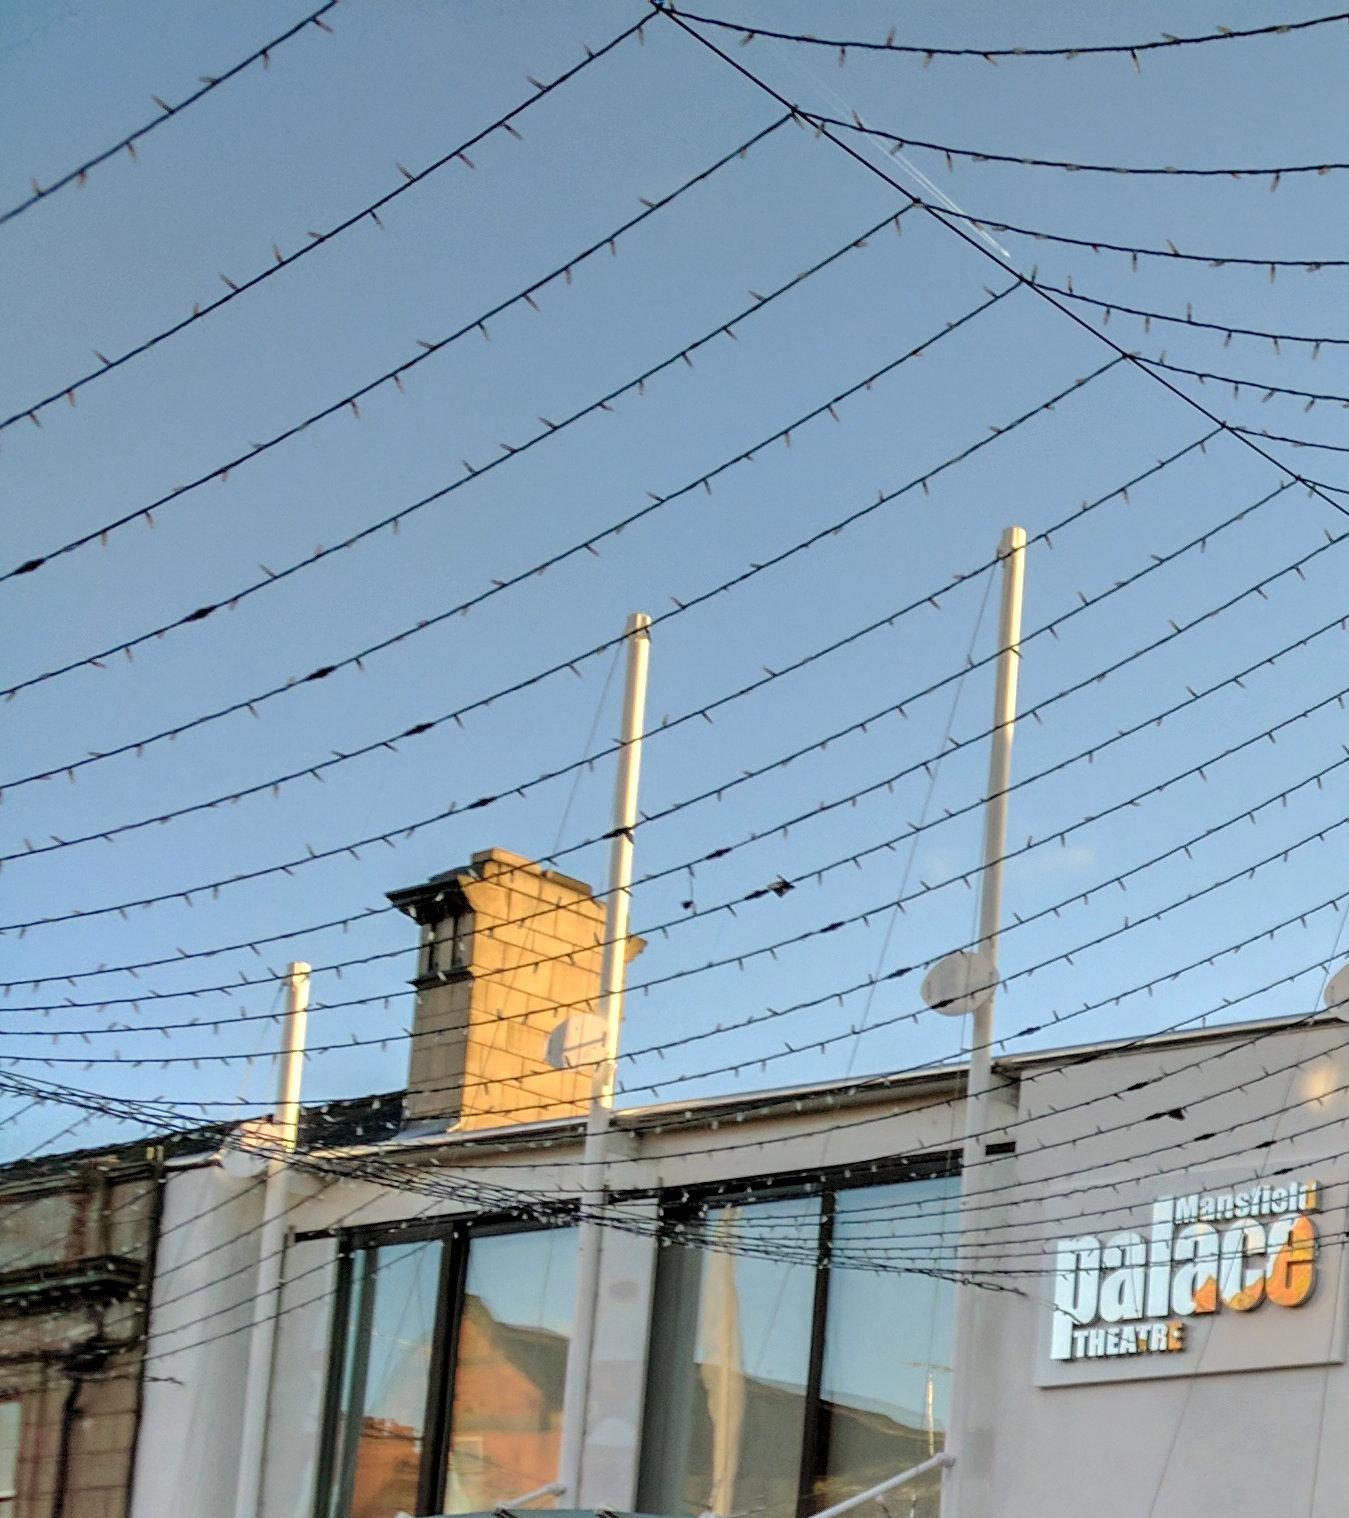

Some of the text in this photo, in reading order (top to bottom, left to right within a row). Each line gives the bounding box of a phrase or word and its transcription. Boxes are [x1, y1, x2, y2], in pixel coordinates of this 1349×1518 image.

[1174, 1177, 1320, 1224] Mansfield
[1050, 1196, 1317, 1360] palace
[1073, 1321, 1184, 1358] THEATRE
